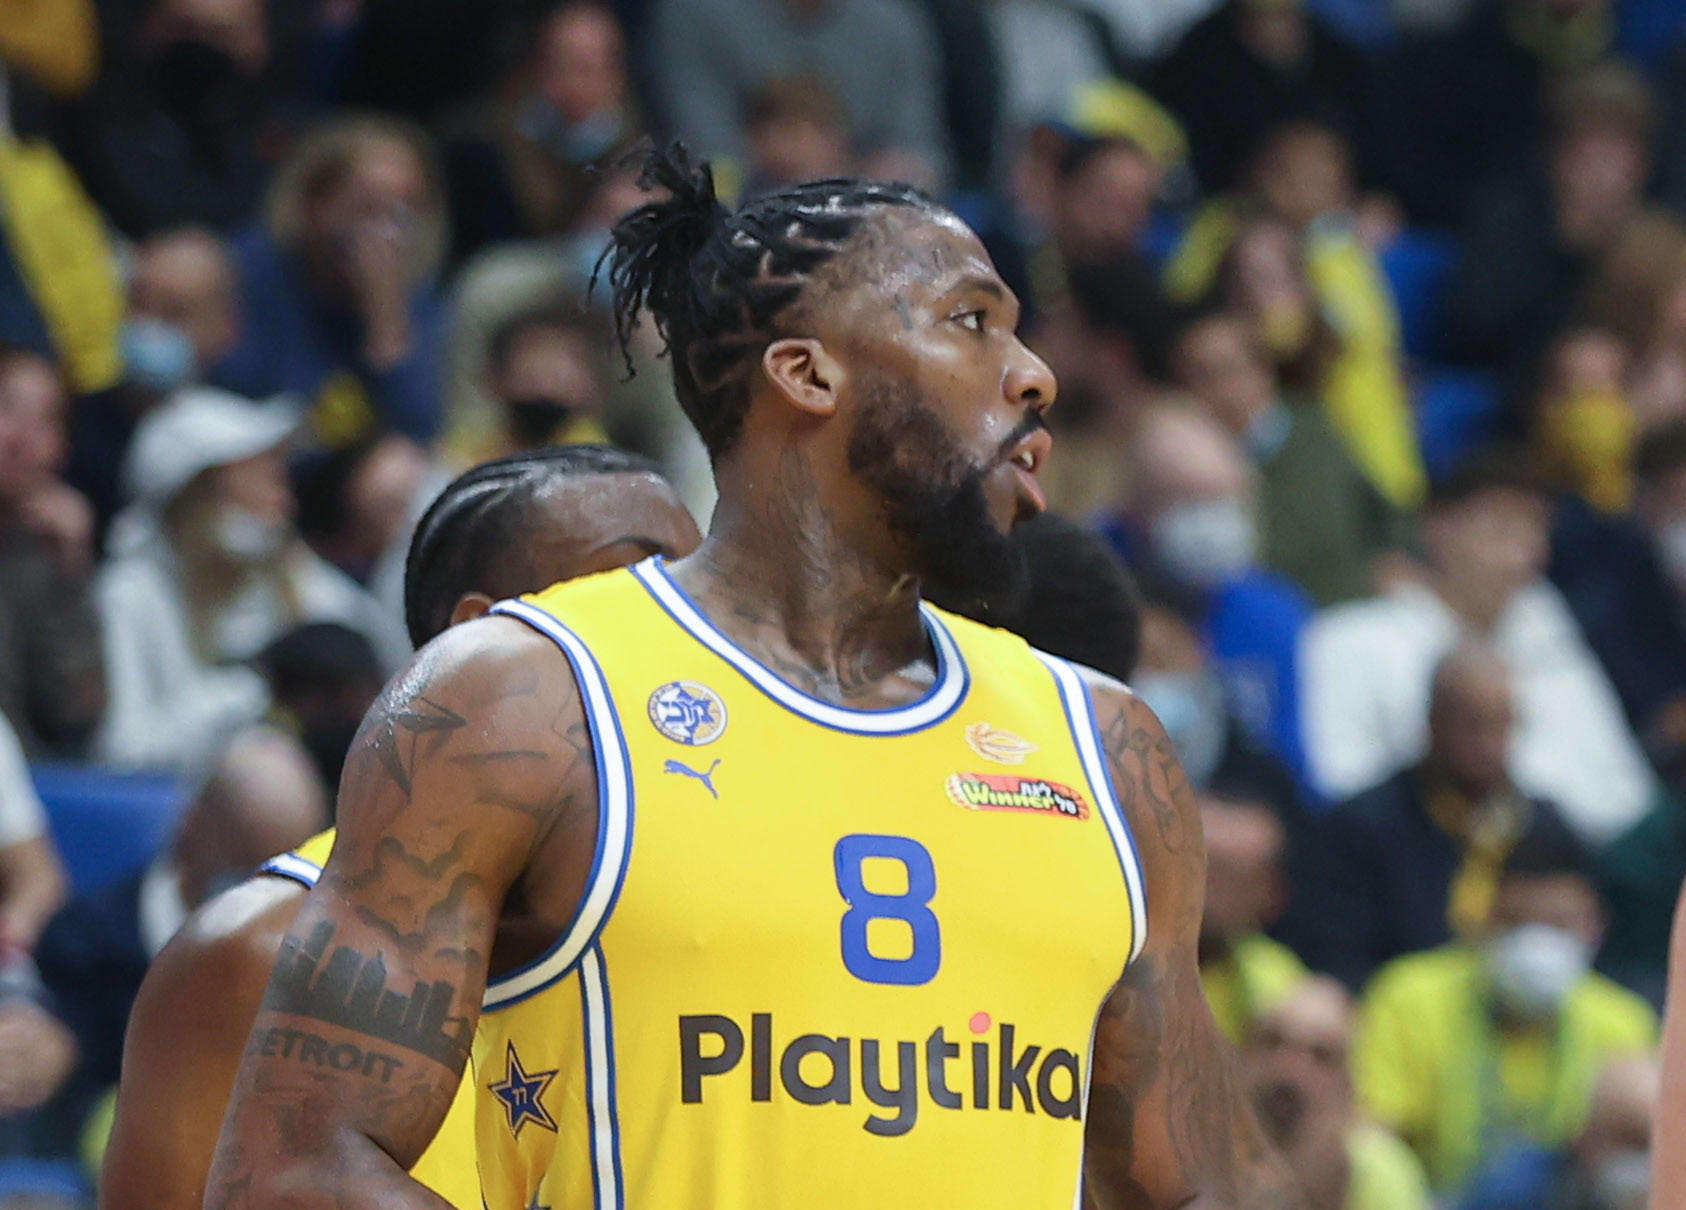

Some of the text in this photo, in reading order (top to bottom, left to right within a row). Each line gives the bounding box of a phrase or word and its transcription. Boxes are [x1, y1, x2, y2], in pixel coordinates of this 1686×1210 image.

[962, 782, 1055, 810] Winner
[833, 833, 942, 986] 8
[678, 1011, 1083, 1138] Playtika
